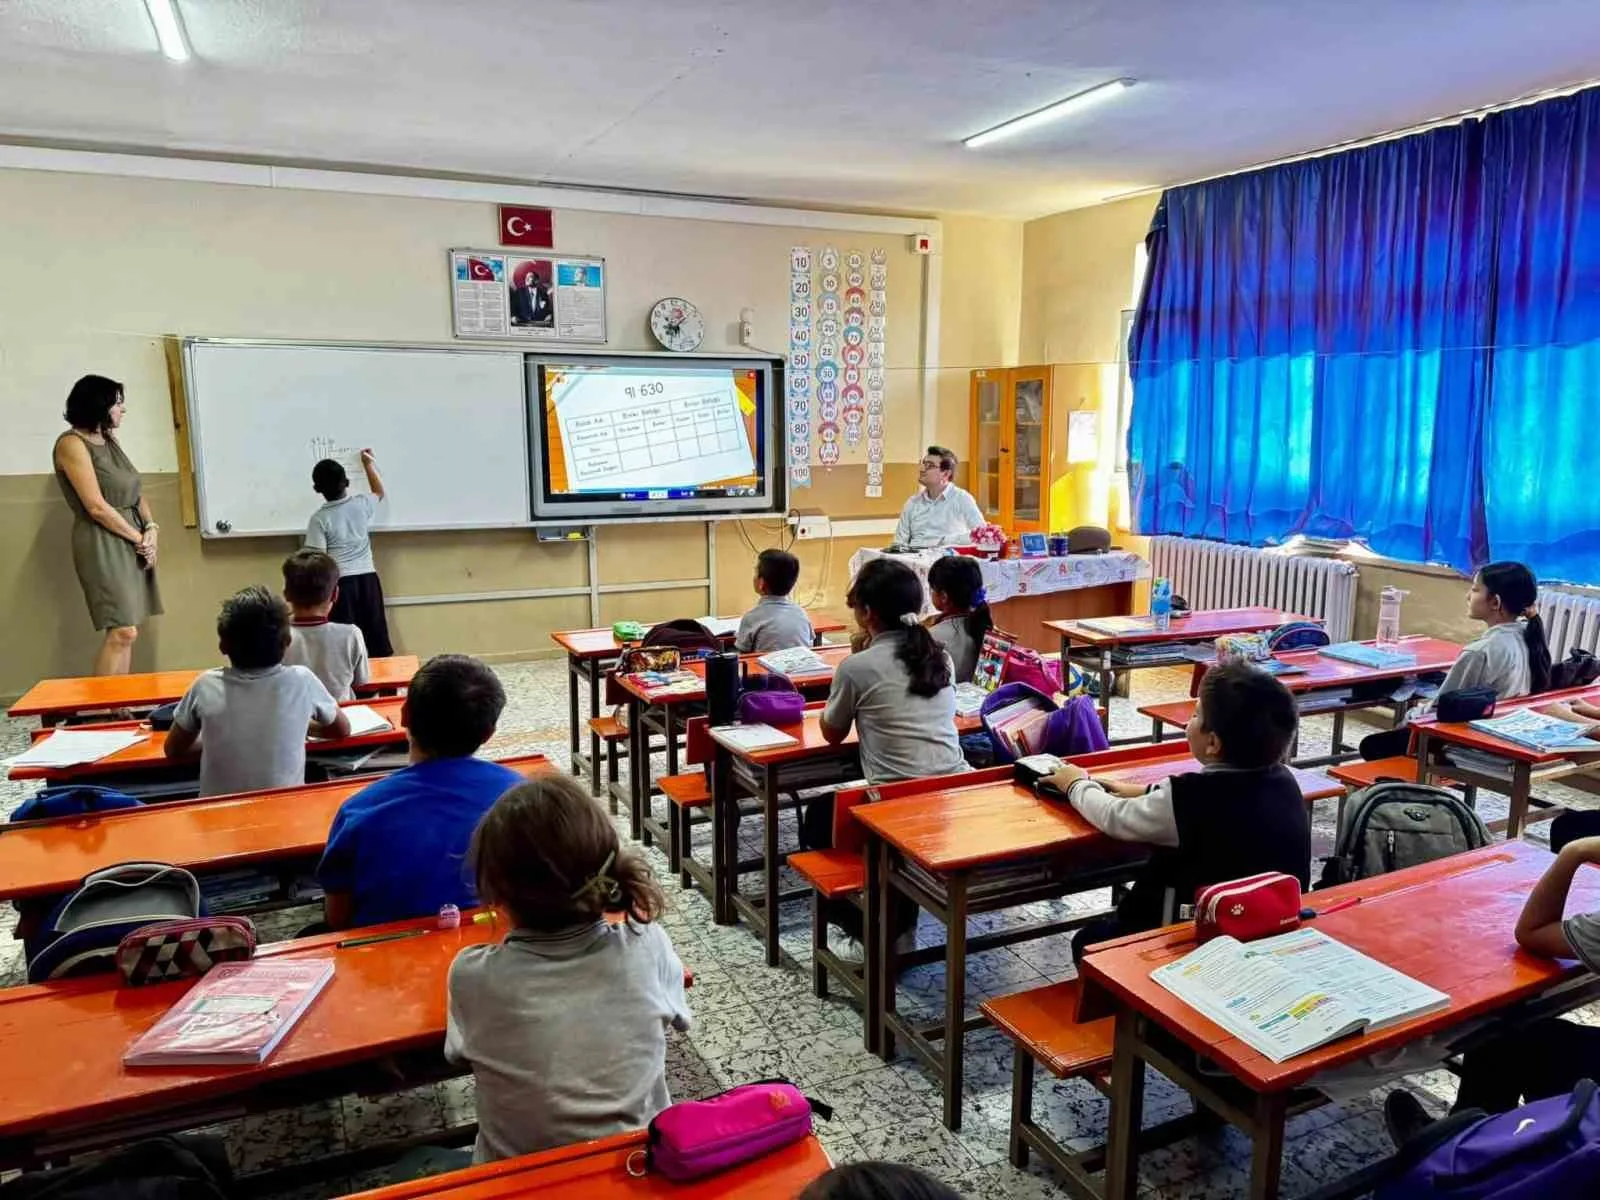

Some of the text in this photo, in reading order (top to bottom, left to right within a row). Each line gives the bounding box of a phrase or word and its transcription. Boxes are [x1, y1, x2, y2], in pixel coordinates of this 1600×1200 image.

[795, 257, 807, 268] 10
[795, 283, 808, 293] 20
[825, 279, 834, 288] 10
[795, 307, 807, 317] 30
[795, 331, 807, 339] 40
[794, 355, 807, 363] 50
[823, 368, 833, 378] 30
[794, 378, 806, 388] 60
[624, 381, 664, 399] 91 630
[794, 401, 806, 410] 70
[794, 424, 806, 433] 80
[794, 446, 807, 455] 90
[793, 469, 808, 477] 100
[1018, 582, 1027, 593] 3
